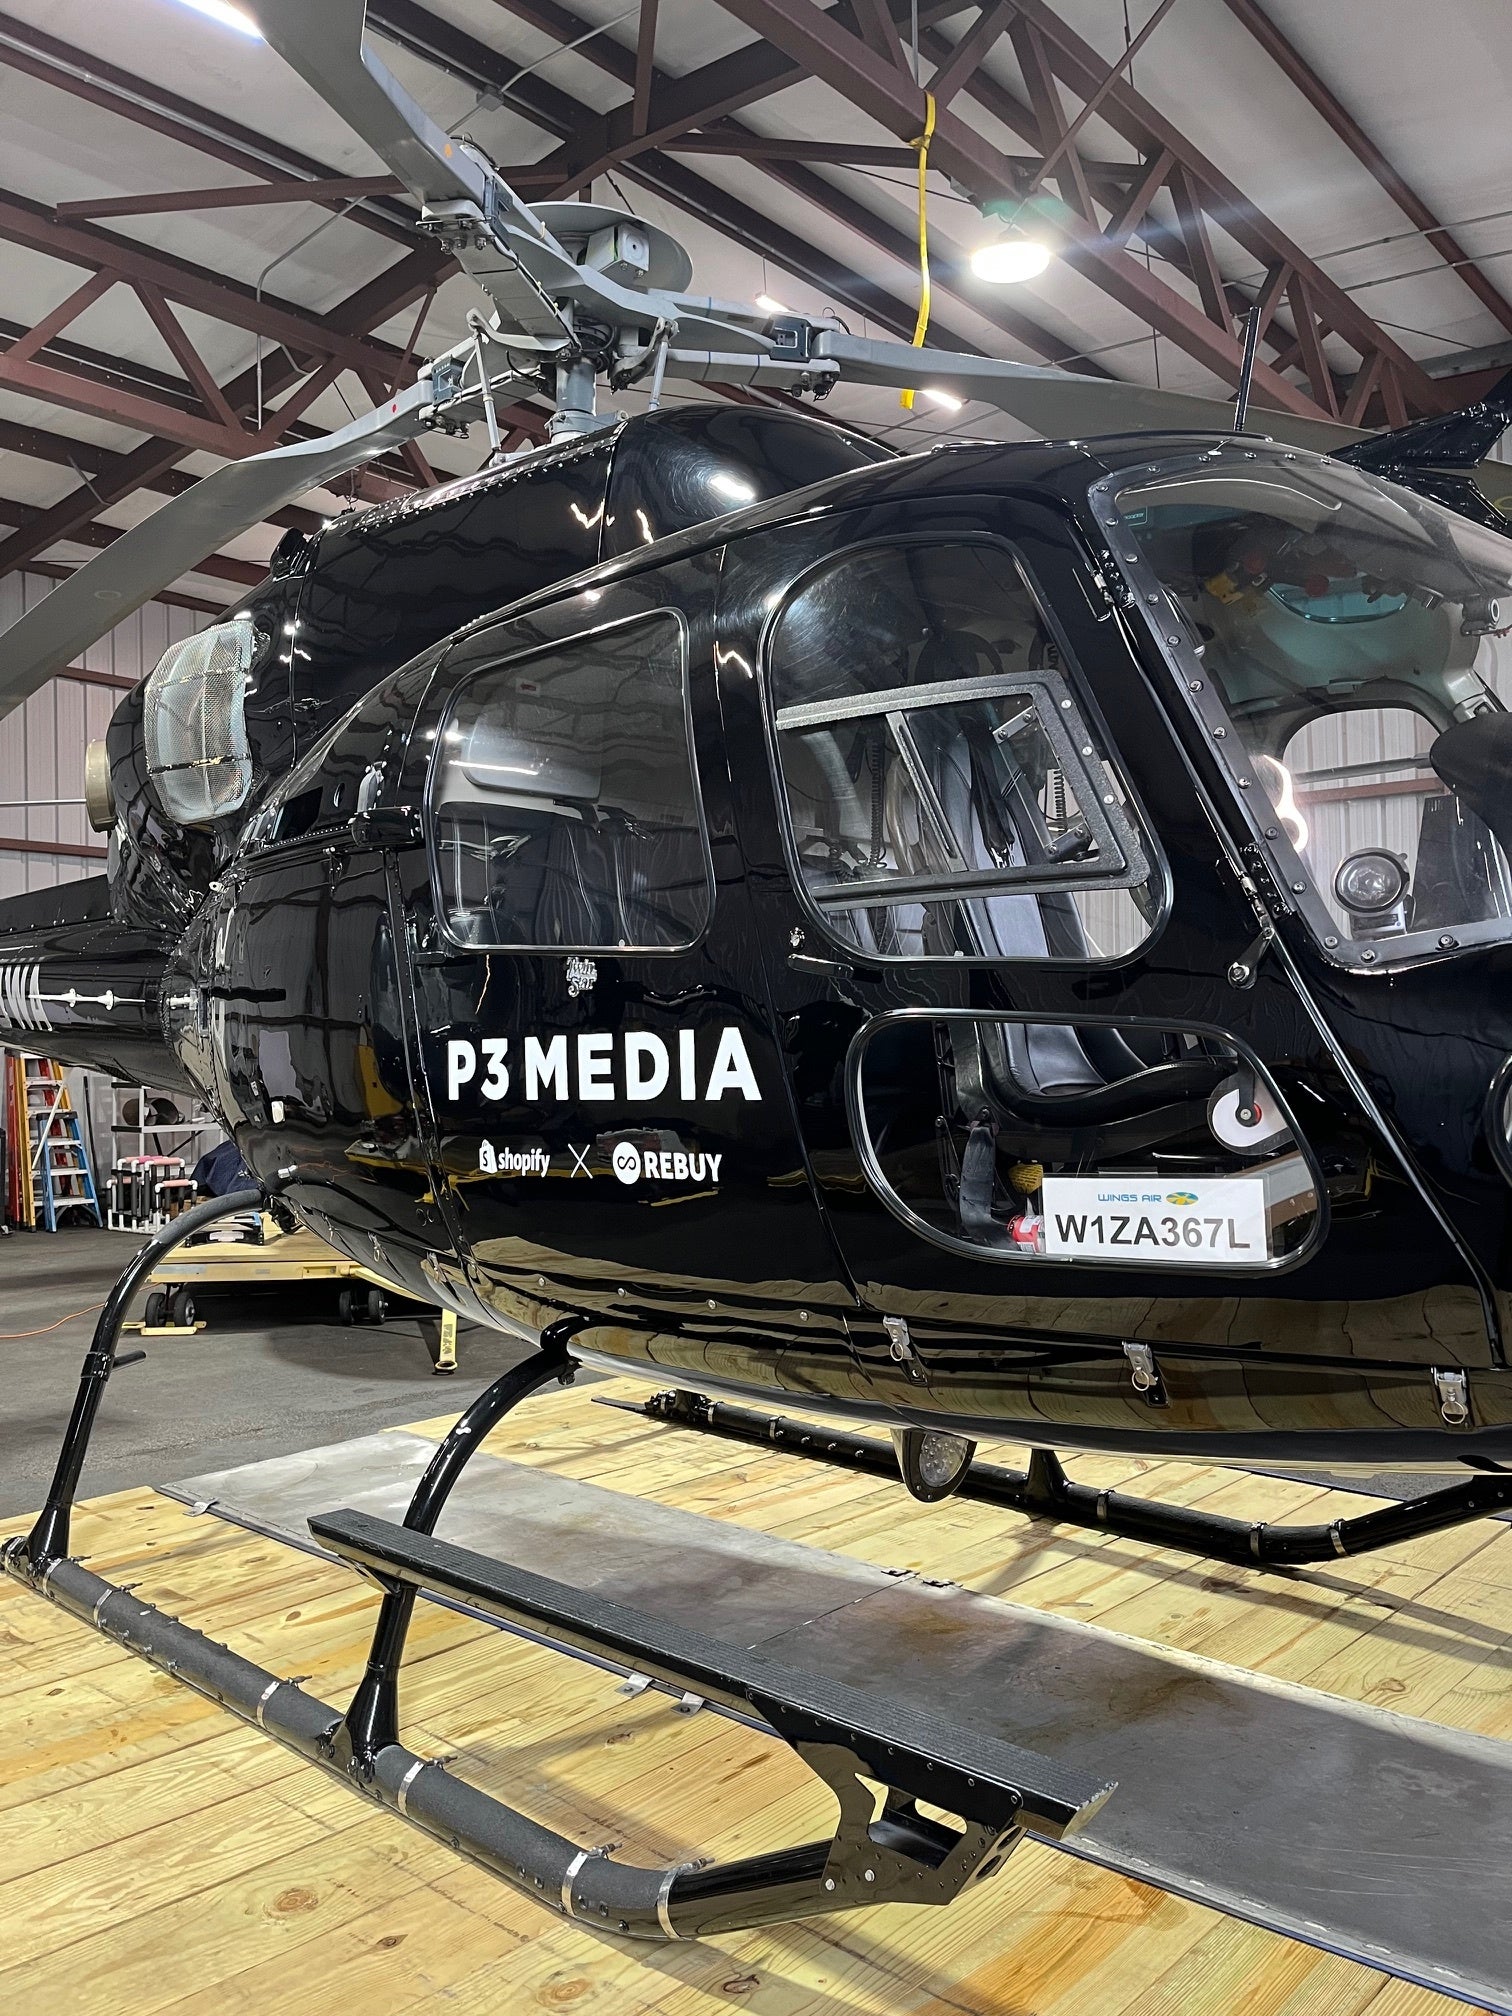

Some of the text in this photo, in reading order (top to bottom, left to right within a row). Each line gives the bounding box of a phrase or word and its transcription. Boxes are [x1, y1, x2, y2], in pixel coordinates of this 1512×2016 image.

[447, 1026, 763, 1101] P3 MEDIA
[498, 1147, 551, 1177] shopify
[644, 1152, 723, 1182] REBUY
[1097, 1193, 1162, 1203] WINGS AIR
[1054, 1214, 1251, 1249] W1ZA367L
